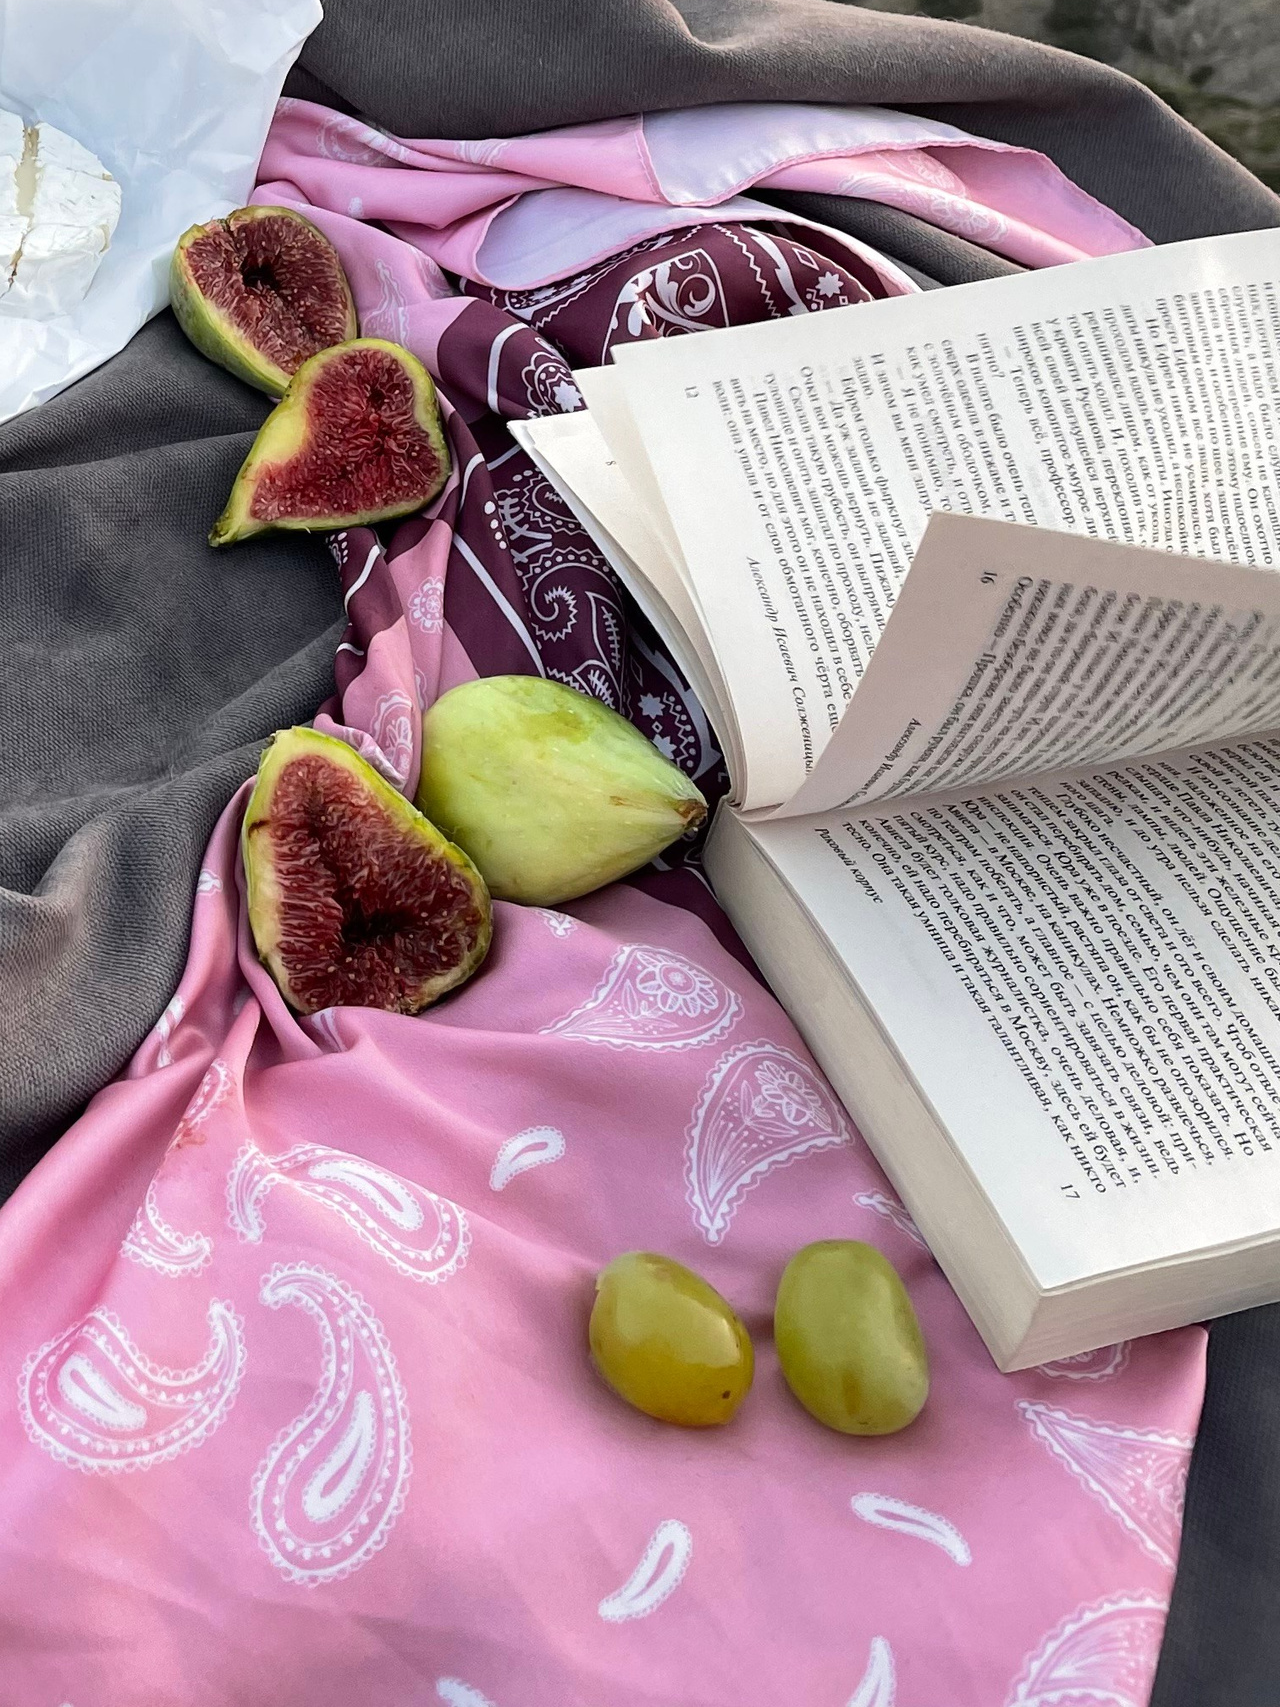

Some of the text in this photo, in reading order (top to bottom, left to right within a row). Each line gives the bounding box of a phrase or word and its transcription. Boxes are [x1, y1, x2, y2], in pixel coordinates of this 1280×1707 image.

[726, 419, 743, 445] она
[733, 447, 759, 487] упала
[751, 490, 764, 500] и
[757, 503, 772, 519] от
[764, 522, 785, 555] слов
[795, 555, 811, 573] он
[778, 558, 820, 653] обмотанного
[979, 571, 998, 585] 16
[745, 556, 780, 623] Александр
[770, 625, 800, 686] Исаевич
[809, 594, 840, 653] находил
[835, 611, 871, 678] оборвать
[814, 656, 834, 699] чёрта
[831, 655, 843, 666] в
[835, 666, 855, 701] себе
[814, 828, 884, 904] Раковый корпус
[841, 821, 1107, 1194] тесно. Она такая умница и такая талантливая, как никто
[858, 819, 1127, 1188] конечно, ей надо перебираться в Москву, здесь ей будет
[875, 817, 1142, 1184] Авиета будет толковая журналистка, очень деловая, и,
[892, 814, 1161, 1179] пятый курс, надо правильно сориентироваться в жизни.
[910, 811, 1180, 1175] смотреться, как и что, может быть завязать связи, ведь
[926, 807, 1197, 1170] по театрам побегать, а главное с целью деловой: при-
[942, 804, 1215, 1166] Авиета в Москве, на каникулах. Немножко развлечься,
[960, 799, 1234, 1161] Юра не напористый, растяпа он, как бы не опозорился.
[976, 796, 1254, 1157] инспекция. Очень важно правильно себя показать. Но
[993, 793, 1273, 1152] заниматься. Юра уже в поезде. Его первая практическая
[1060, 1184, 1081, 1199] 17
